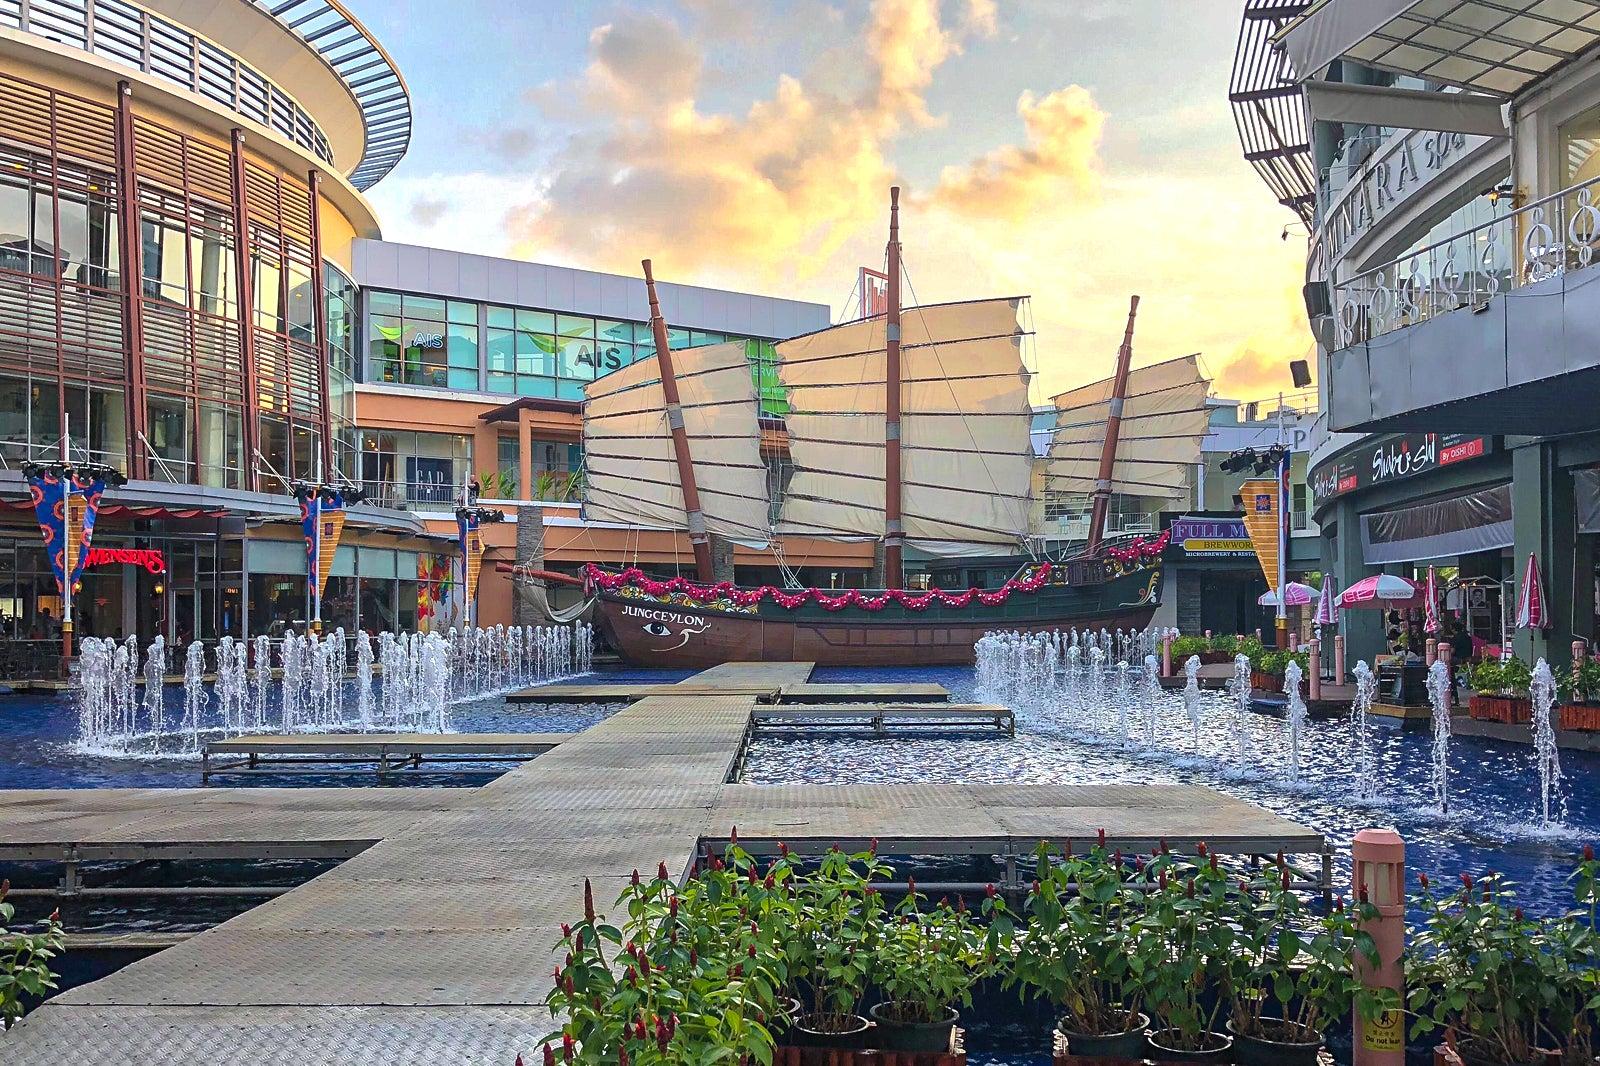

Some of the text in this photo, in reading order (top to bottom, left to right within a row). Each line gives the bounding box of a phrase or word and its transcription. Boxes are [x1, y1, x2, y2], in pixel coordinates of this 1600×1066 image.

[413, 332, 443, 349] AIS
[574, 345, 621, 370] AIS
[416, 469, 444, 491] GAP
[1175, 524, 1247, 538] FULL M
[1204, 541, 1254, 549] BREWWOR
[621, 605, 705, 626] JUNGCEYLON
